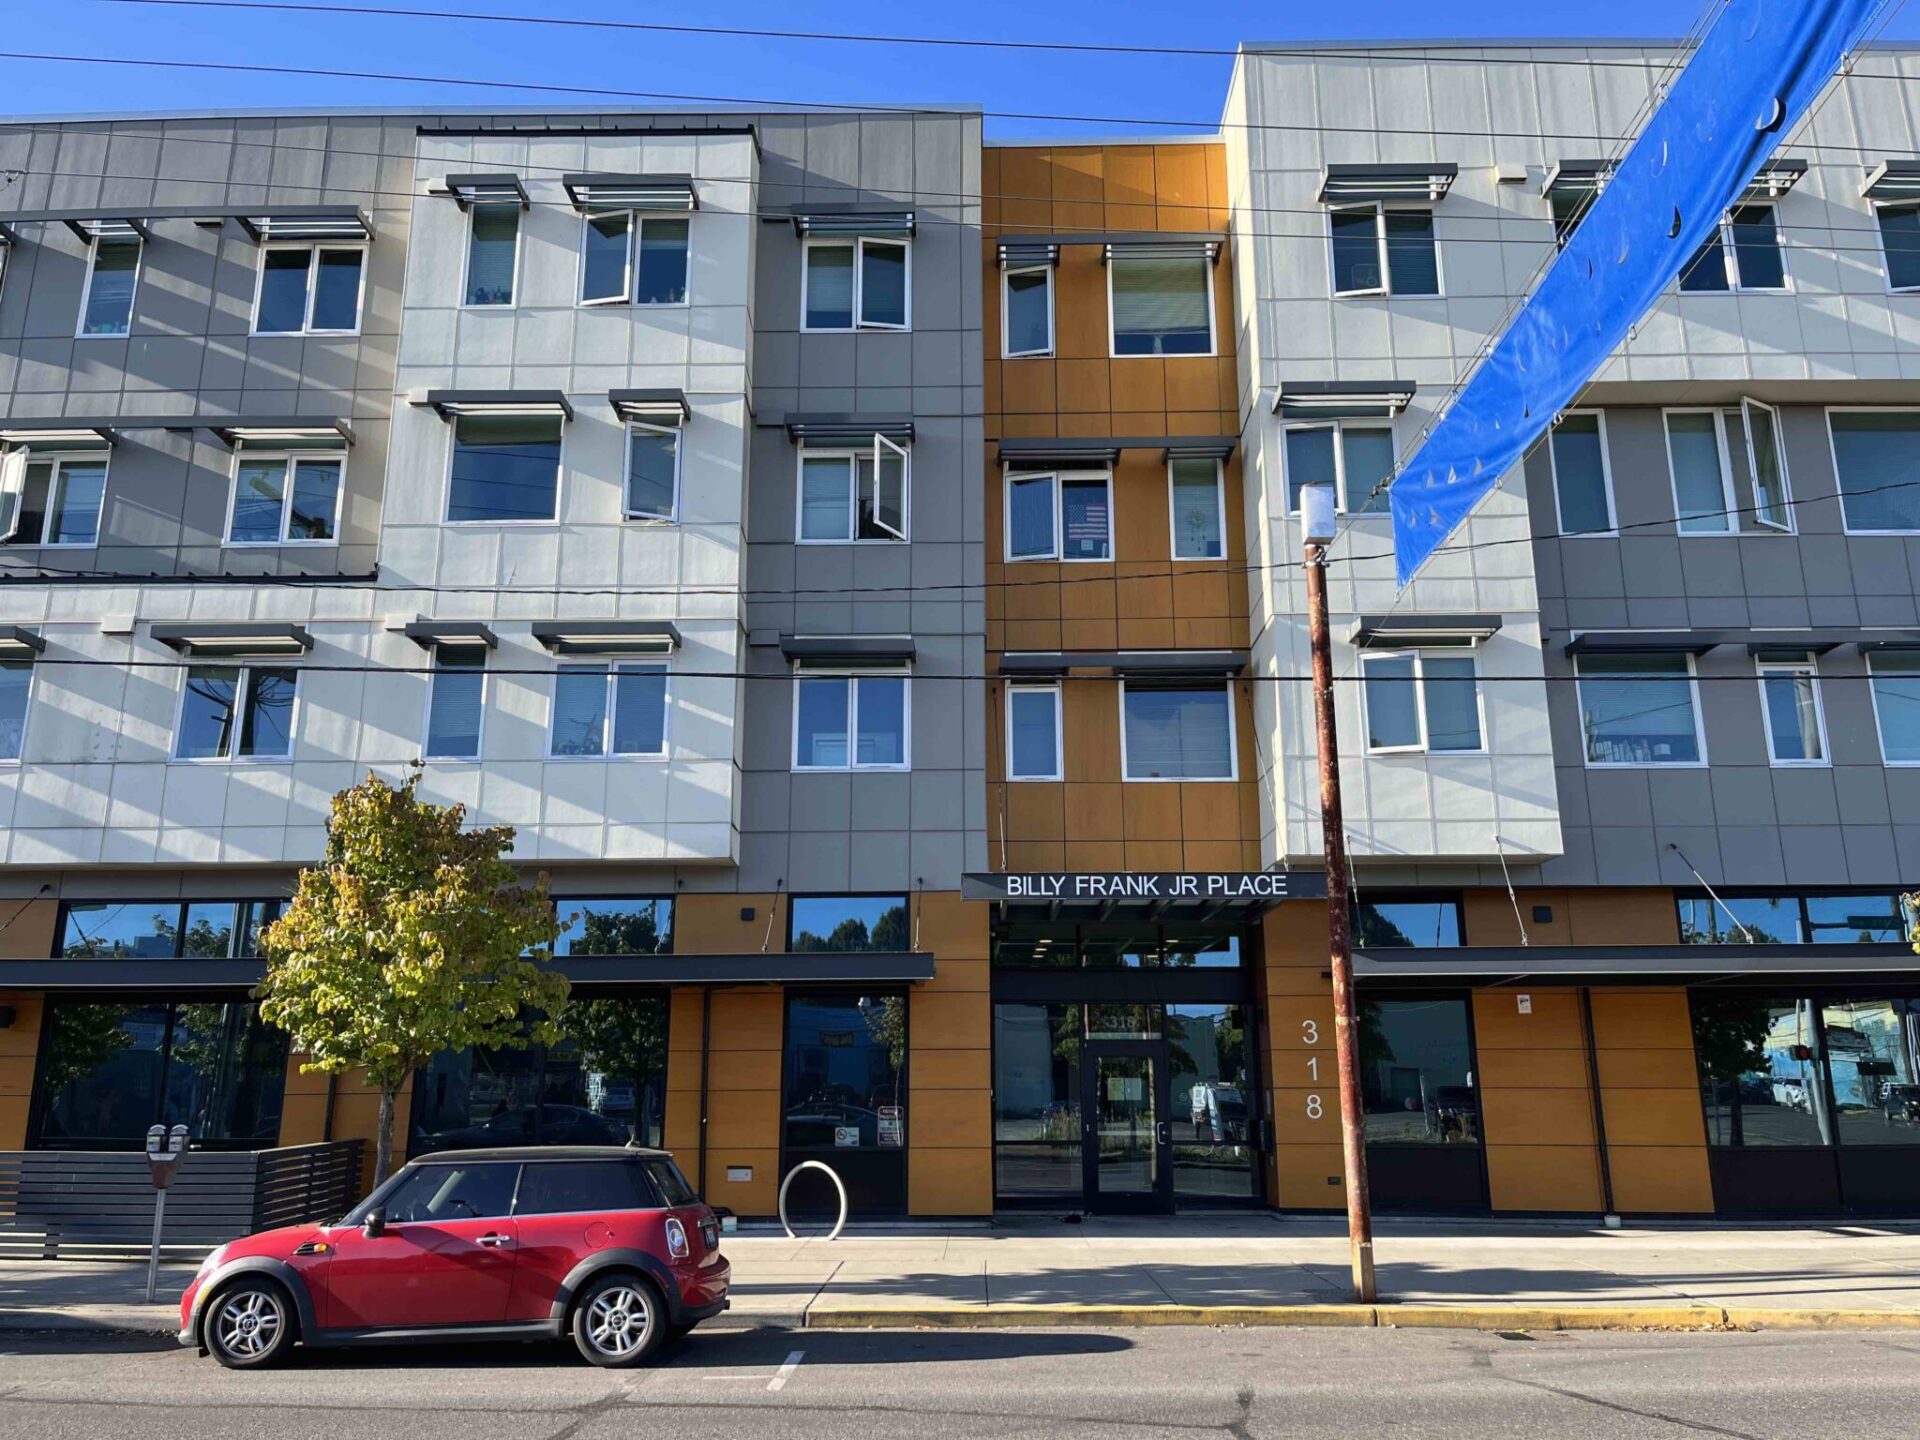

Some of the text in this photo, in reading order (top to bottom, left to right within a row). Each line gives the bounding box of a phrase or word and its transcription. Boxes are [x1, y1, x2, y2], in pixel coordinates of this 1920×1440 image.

[1007, 875, 1288, 896] BILLY FRANK JR PLACE
